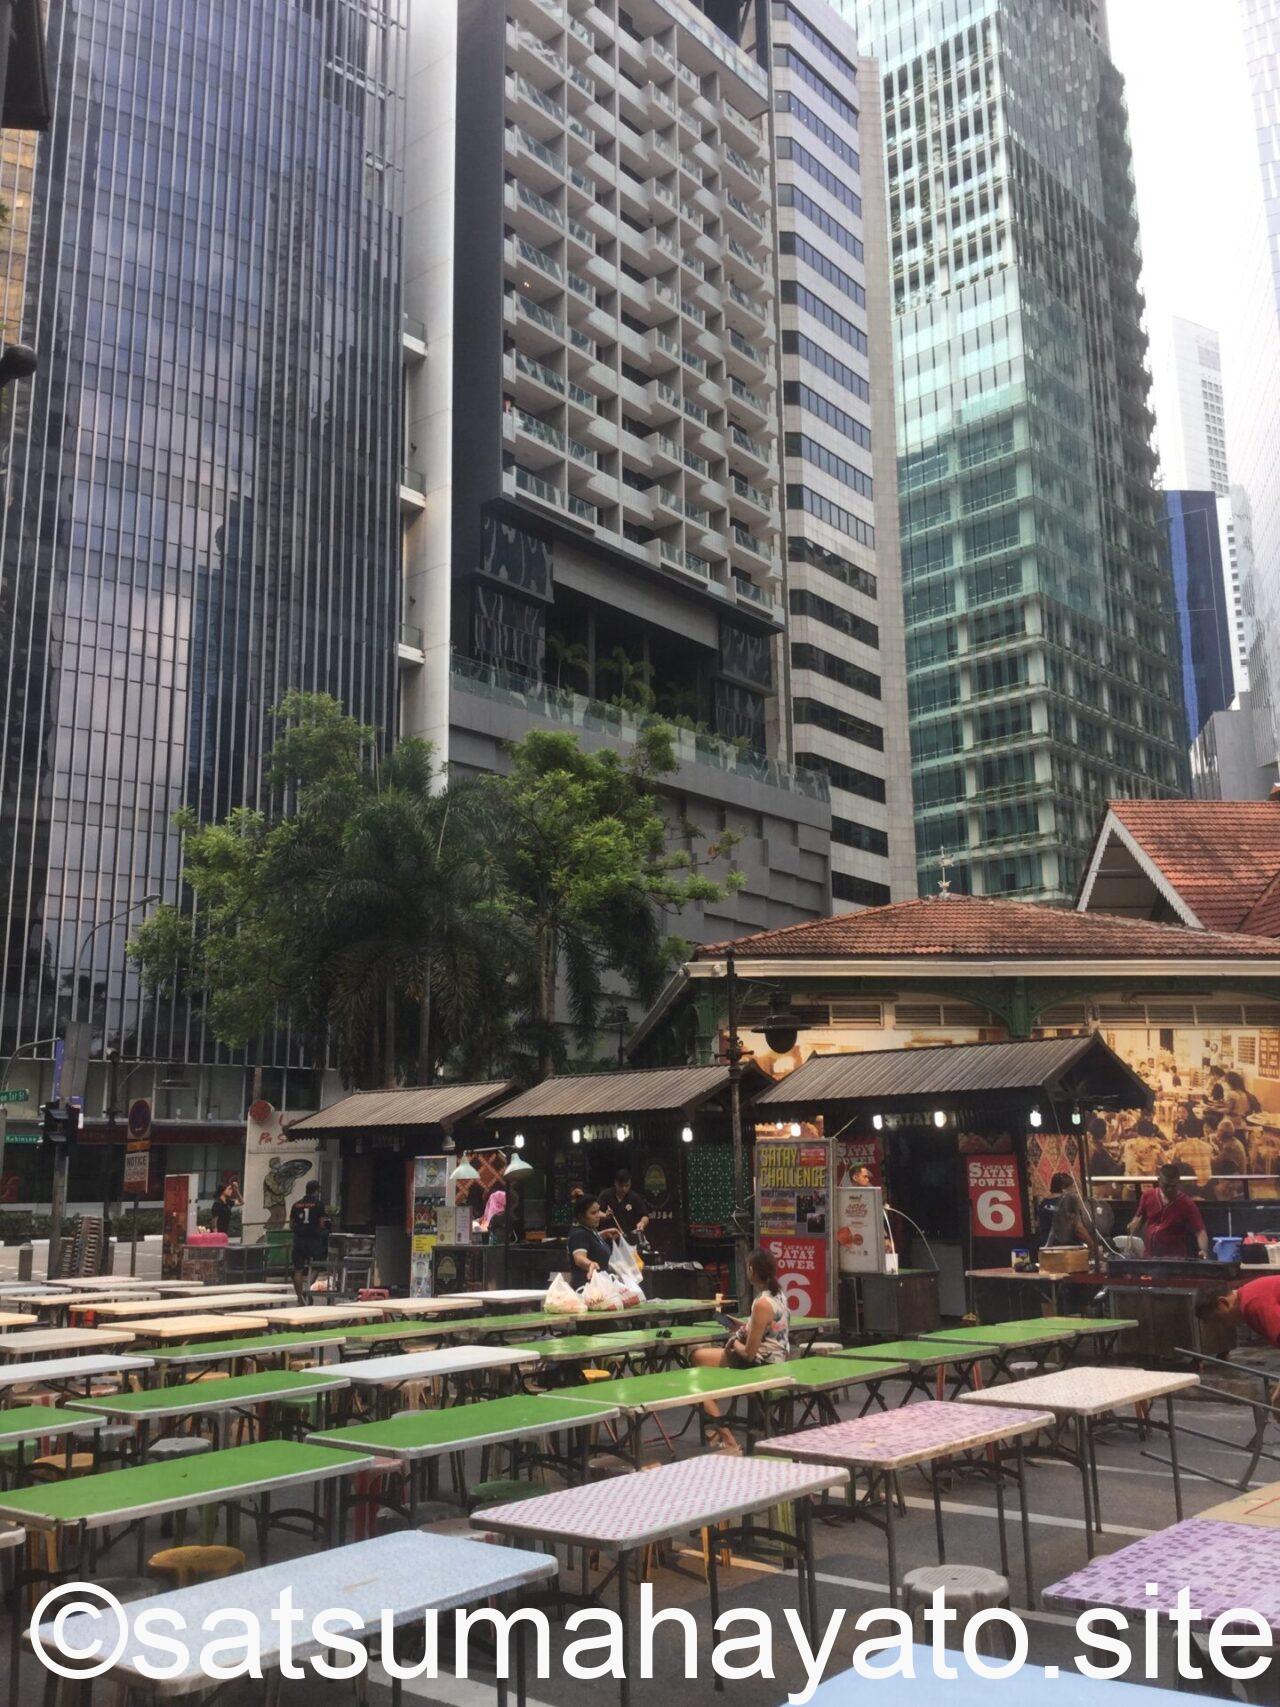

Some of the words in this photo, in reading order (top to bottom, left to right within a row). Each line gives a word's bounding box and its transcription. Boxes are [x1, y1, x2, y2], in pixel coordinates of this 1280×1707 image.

[761, 1146, 797, 1167] SATAY
[836, 1142, 876, 1156] SATAY
[126, 1156, 147, 1168] NOTICE
[969, 1162, 1014, 1178] SATAY
[760, 1167, 826, 1188] CHALLENGE
[969, 1178, 1016, 1187] POWER
[303, 1208, 310, 1224] 1
[977, 1190, 1016, 1232] 6
[769, 1241, 816, 1260] SATAY
[777, 1259, 816, 1270] OWER
[777, 1272, 812, 1317] 6
